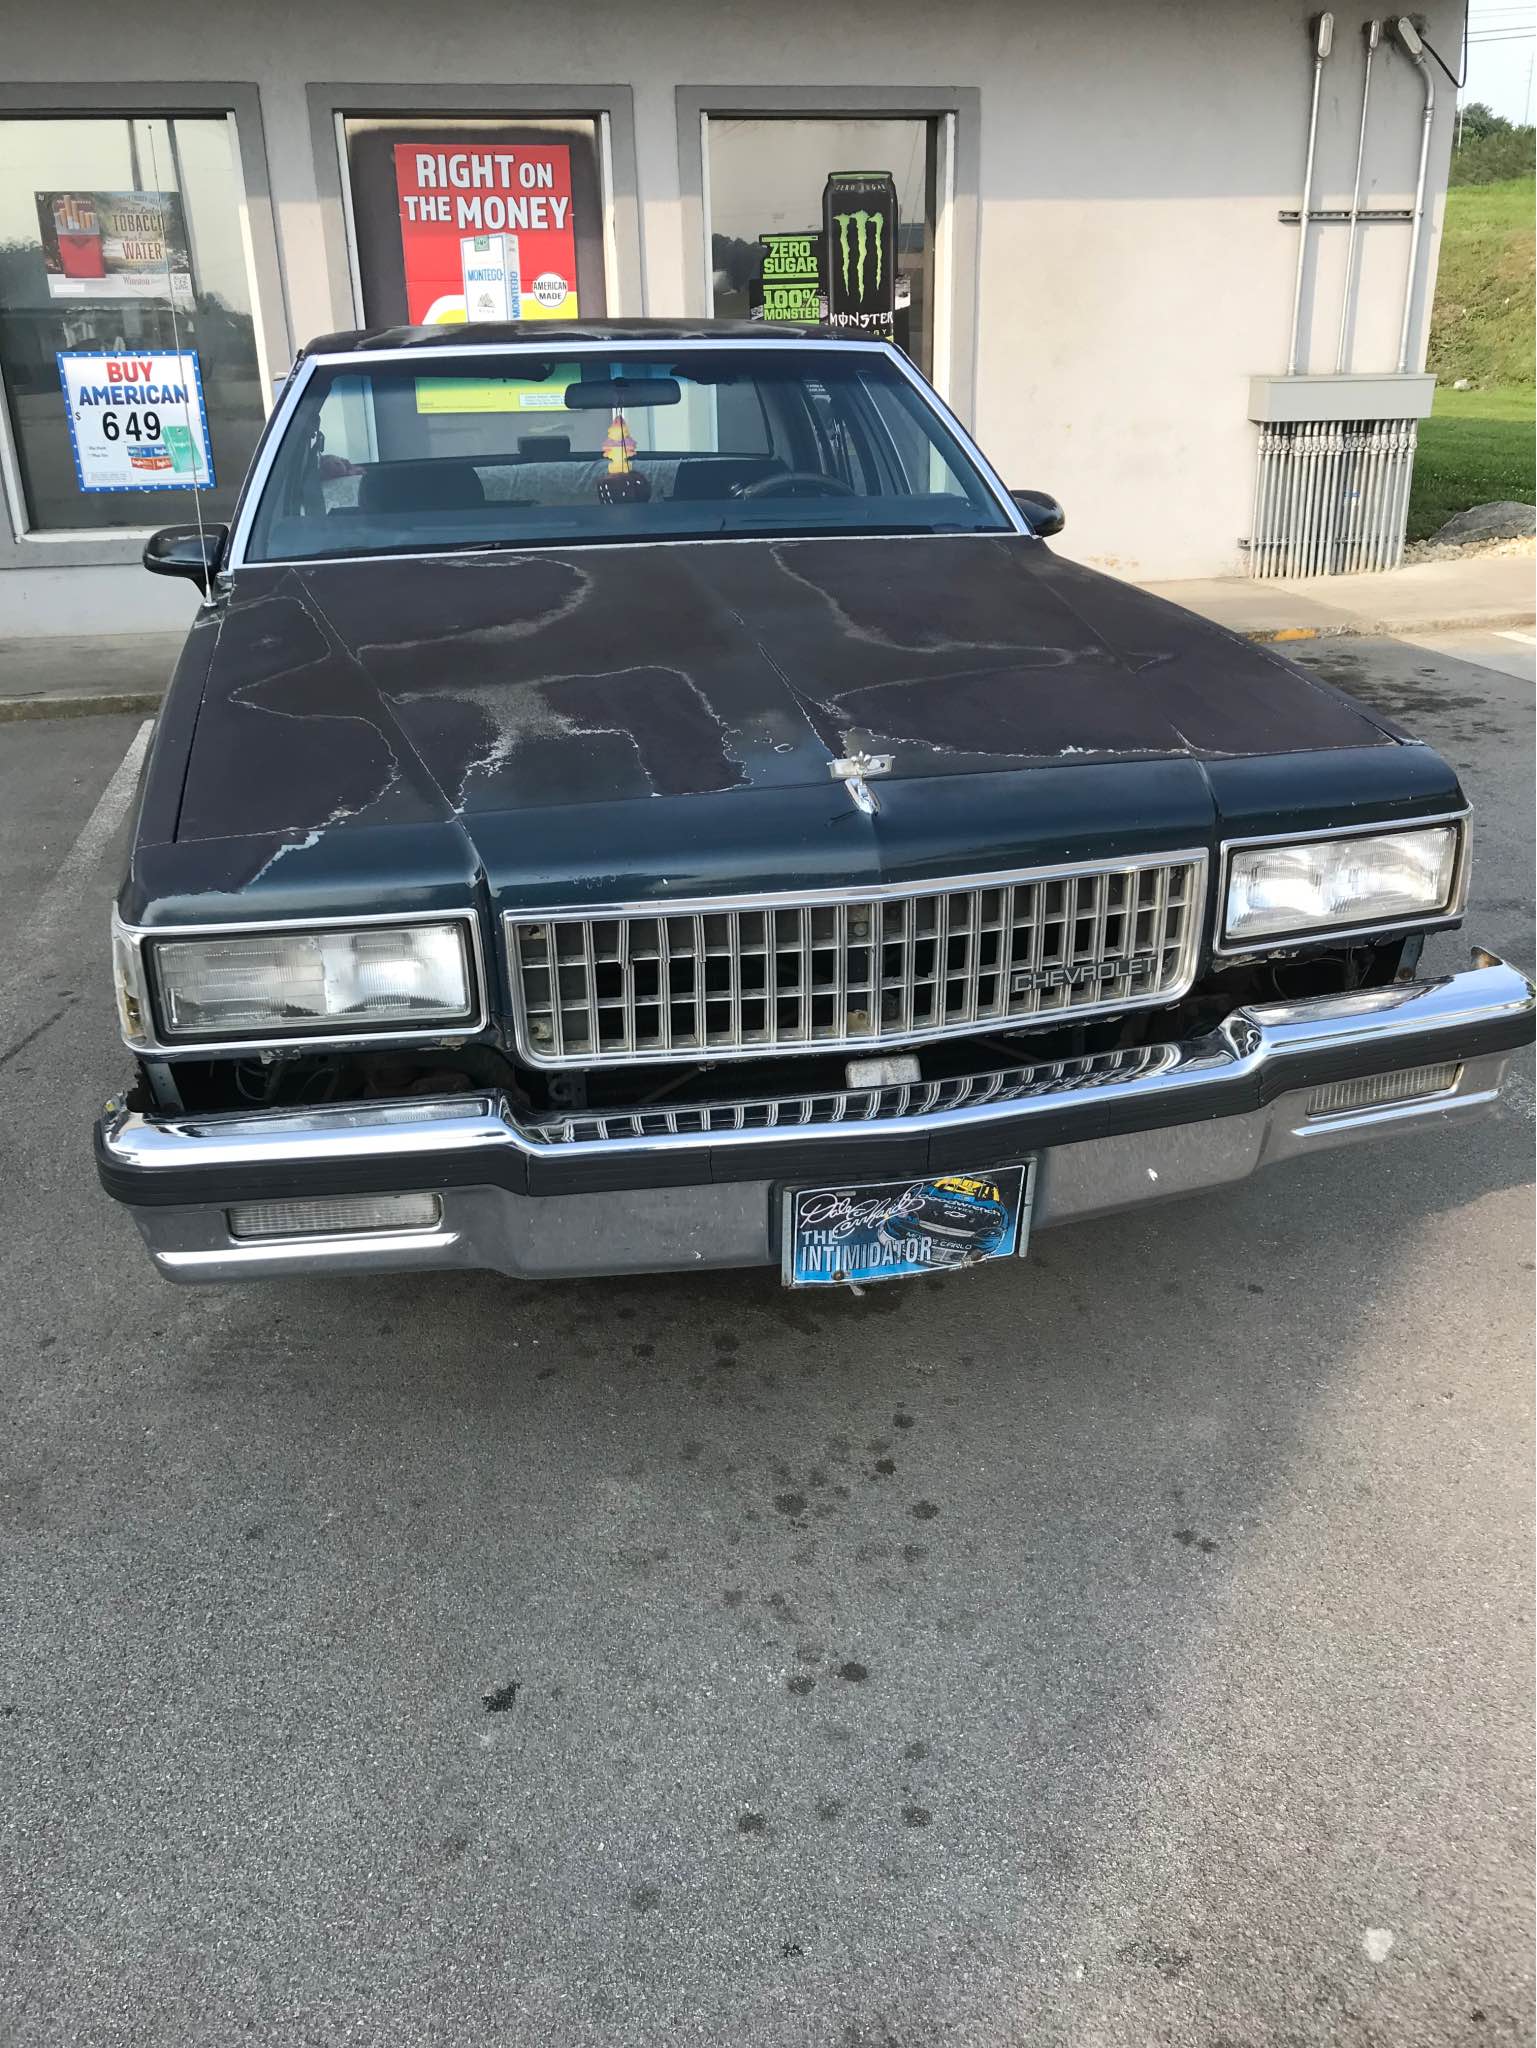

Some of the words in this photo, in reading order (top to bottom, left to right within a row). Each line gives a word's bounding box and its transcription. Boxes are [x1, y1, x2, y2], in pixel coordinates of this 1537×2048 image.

[416, 154, 514, 188] RIGHT
[519, 163, 553, 188] ON
[404, 196, 451, 221] THE
[457, 196, 568, 229] MONEY
[112, 214, 165, 231] TOBACCO
[122, 242, 163, 260] WATER
[769, 242, 811, 258] ZERO
[763, 256, 818, 274] SUGAR
[467, 269, 502, 281] MONTEGO
[510, 271, 521, 319] MONTEGO
[533, 281, 567, 291] AMERICAN
[539, 292, 562, 300] MADE
[763, 289, 820, 309] 100%
[764, 307, 820, 321] MONSTER
[829, 311, 894, 328] MONSTER
[106, 361, 153, 383] BUY
[80, 384, 189, 406] AMERICAN
[1014, 956, 1157, 992] CHEVROLET
[801, 1229, 839, 1246] THE
[802, 1236, 932, 1272] INTIMIDATOR
